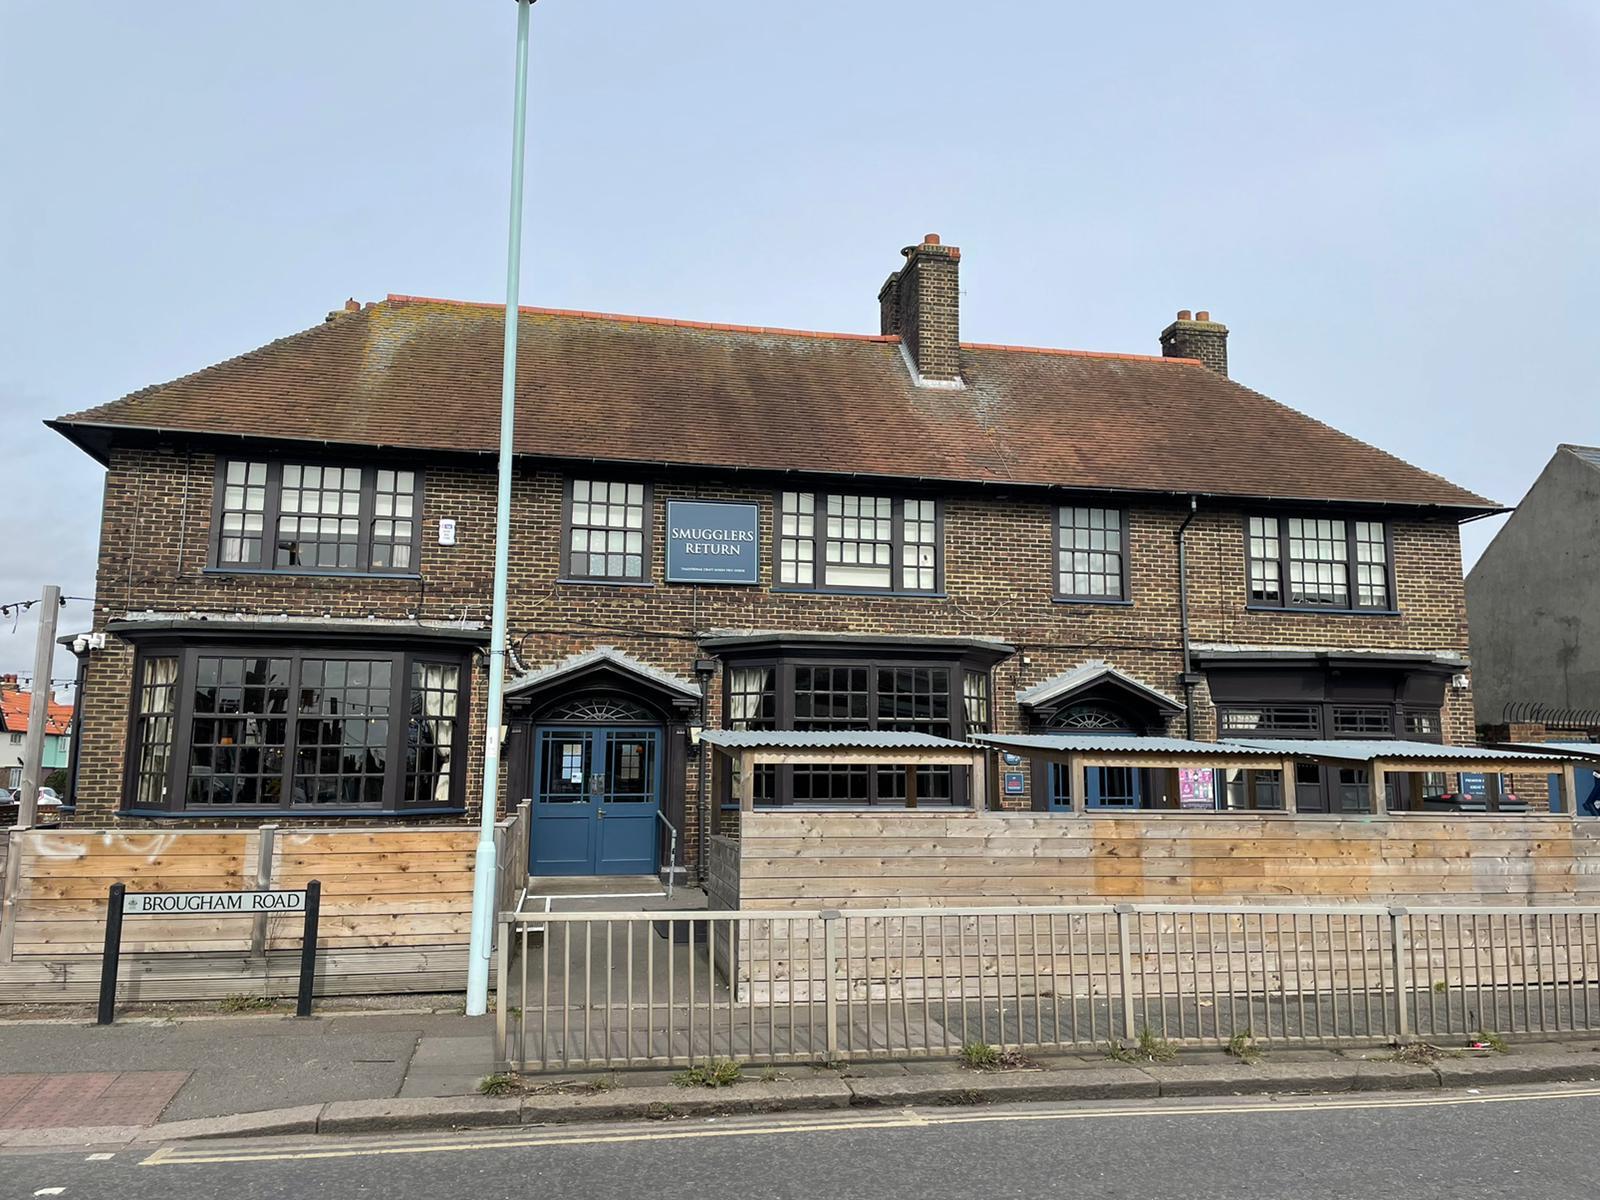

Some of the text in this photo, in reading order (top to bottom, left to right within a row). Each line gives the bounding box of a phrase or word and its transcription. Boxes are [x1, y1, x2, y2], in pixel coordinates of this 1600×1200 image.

[672, 527, 754, 541] SMUGGLERS
[685, 543, 740, 555] RETURN
[142, 894, 300, 911] BROUGHAM ROAD
